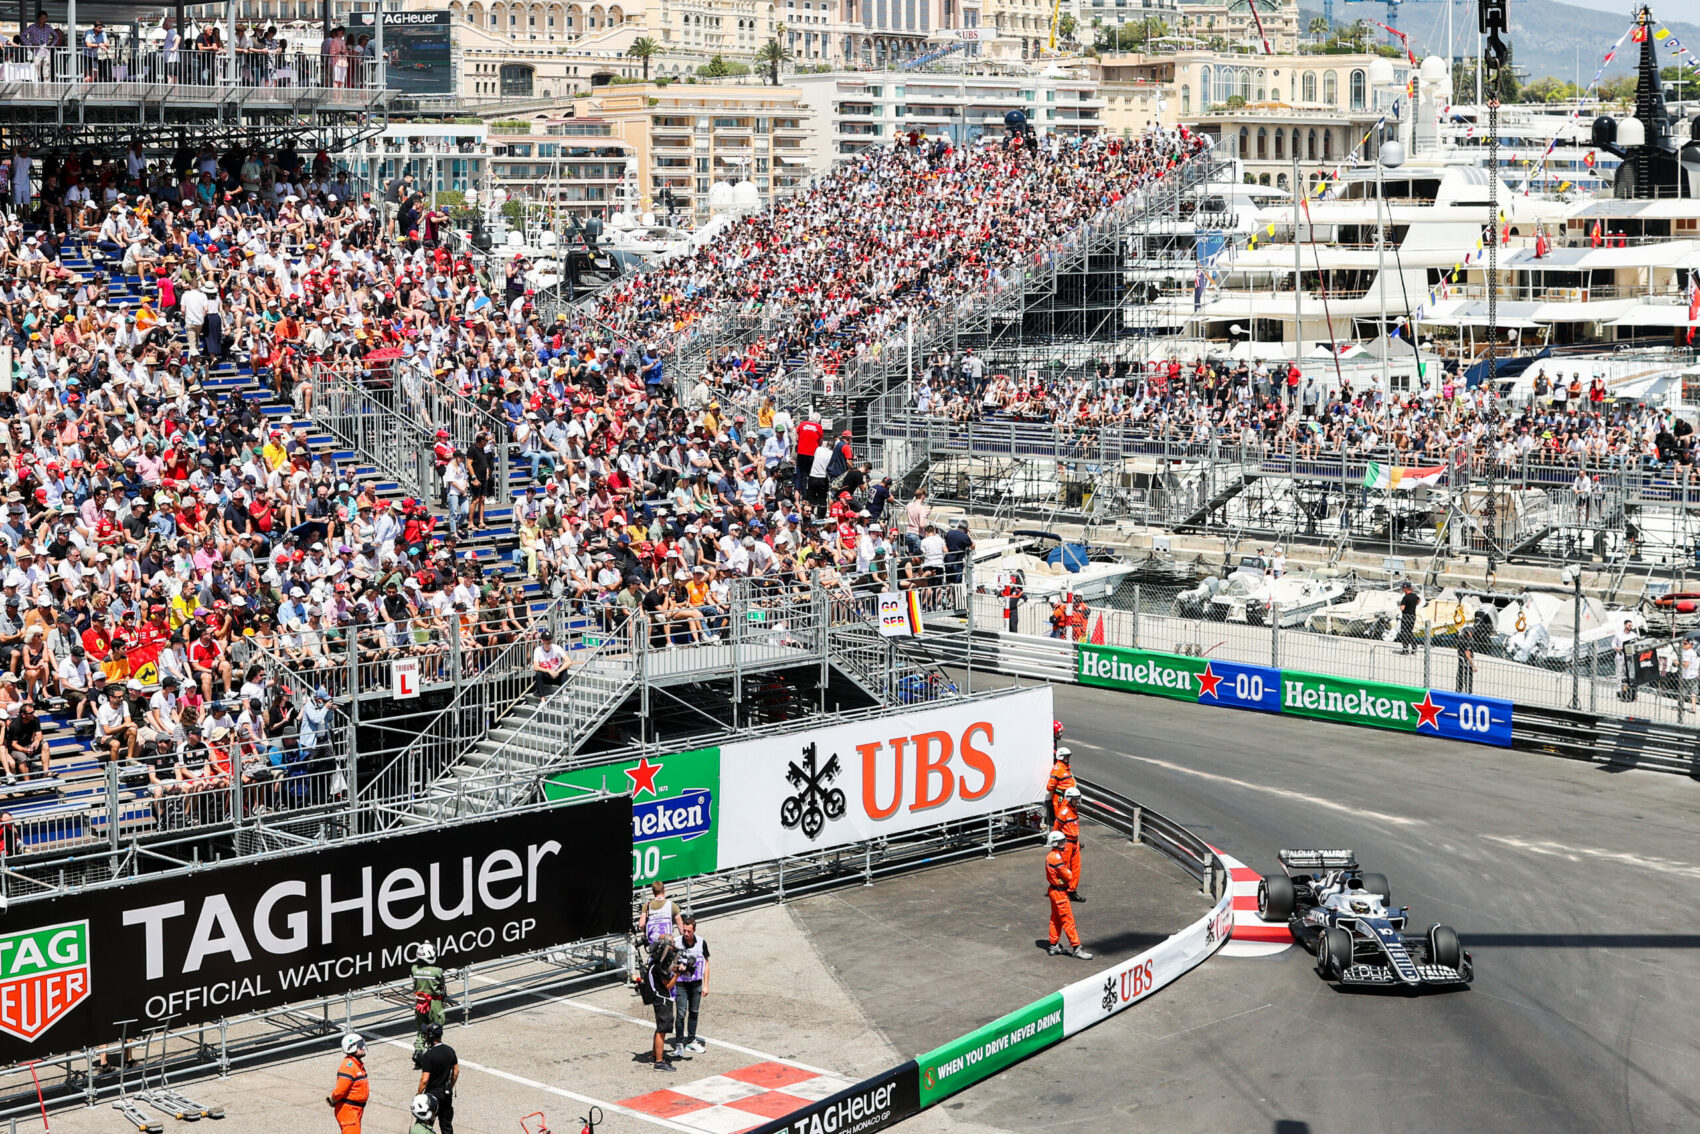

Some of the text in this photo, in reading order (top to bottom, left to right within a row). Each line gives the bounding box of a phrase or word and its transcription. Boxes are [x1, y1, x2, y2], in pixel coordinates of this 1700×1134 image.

[382, 13, 438, 24] AGHeuer
[962, 30, 979, 39] UBS
[881, 601, 898, 612] GO
[400, 674, 412, 695] L
[1081, 651, 1263, 702] Heineken 0.0
[1284, 680, 1490, 733] Heineken 0.0
[856, 721, 996, 821] UBS
[1377, 928, 1393, 936] 10
[145, 918, 536, 1019] OFFICIAL WATCH MOACO GP
[1120, 958, 1153, 1002] UBS
[937, 1009, 1061, 1080] WHEN YOU DRIVE NEVER DRINK
[852, 1115, 880, 1133] MONACO
